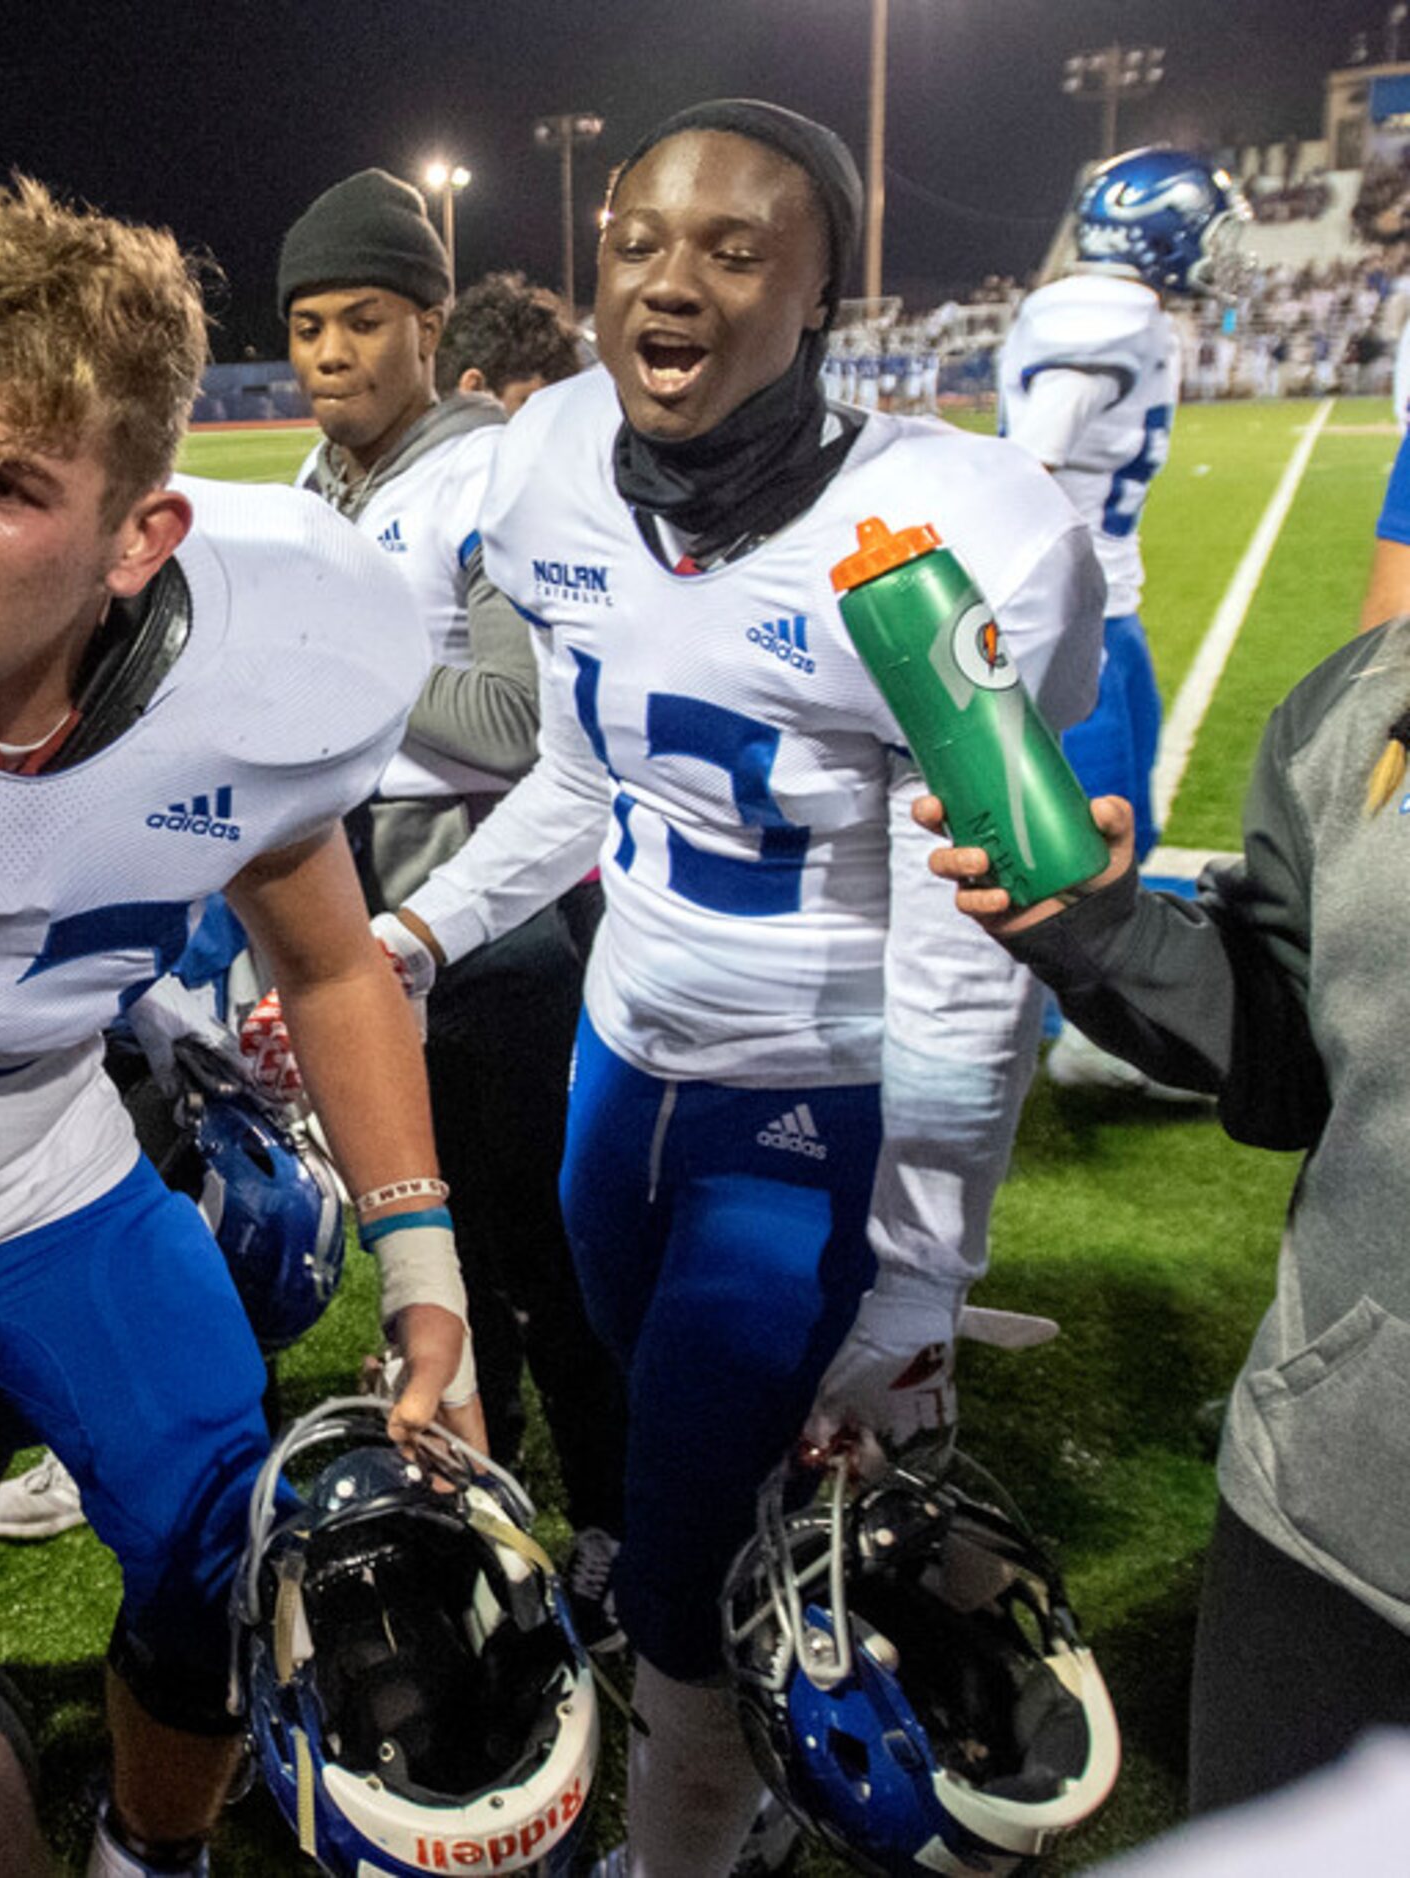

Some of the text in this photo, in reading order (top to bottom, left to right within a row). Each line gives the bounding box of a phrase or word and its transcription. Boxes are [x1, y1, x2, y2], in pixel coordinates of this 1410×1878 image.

[532, 559, 608, 593] NOLAN
[745, 626, 816, 675] adidas
[146, 811, 241, 841] adidas
[756, 1130, 828, 1160] adidas
[416, 1777, 583, 1871] Riddell
